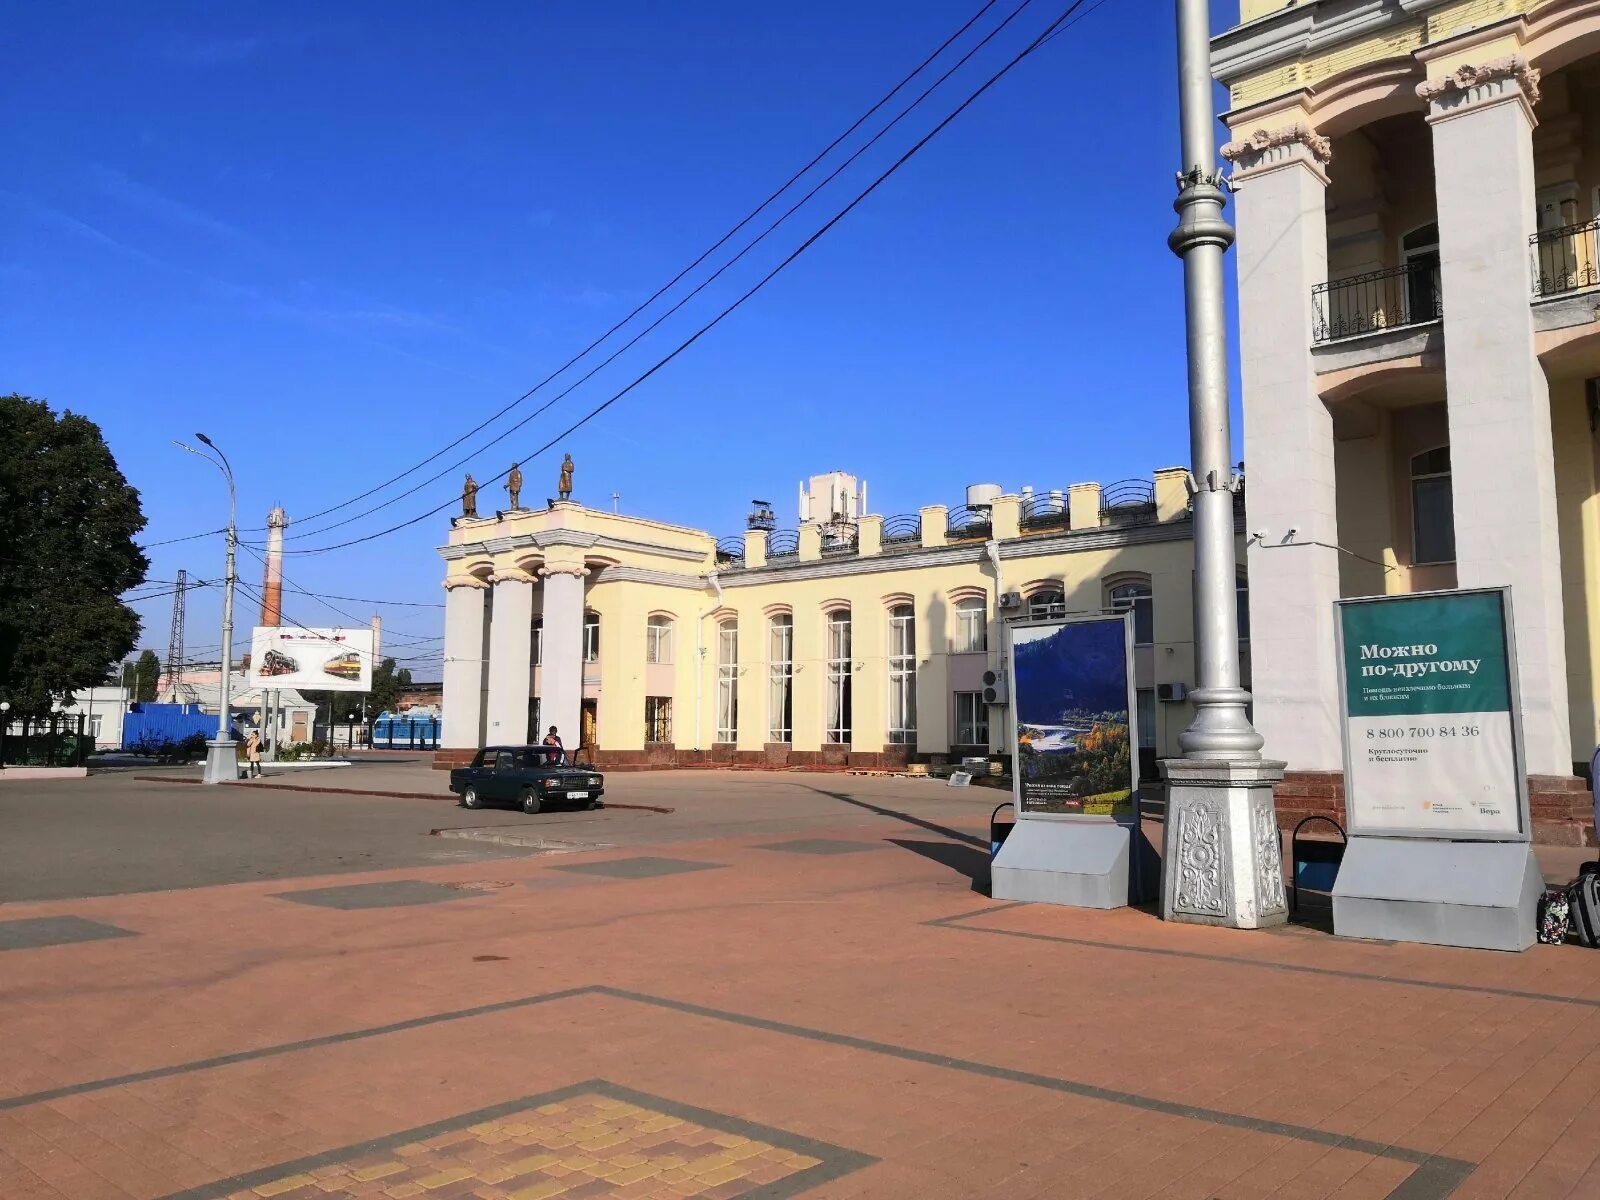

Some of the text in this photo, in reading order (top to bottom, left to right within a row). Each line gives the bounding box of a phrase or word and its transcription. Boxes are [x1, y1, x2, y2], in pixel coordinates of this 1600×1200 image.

[1360, 643, 1438, 660] Можно
[1361, 658, 1481, 678] по-другому
[1437, 683, 1471, 691] больным
[1379, 693, 1410, 701] близким
[1366, 725, 1480, 739] 8 800 700 84 36
[1368, 748, 1429, 756] Круглосуточно
[1480, 807, 1501, 816] Вера
